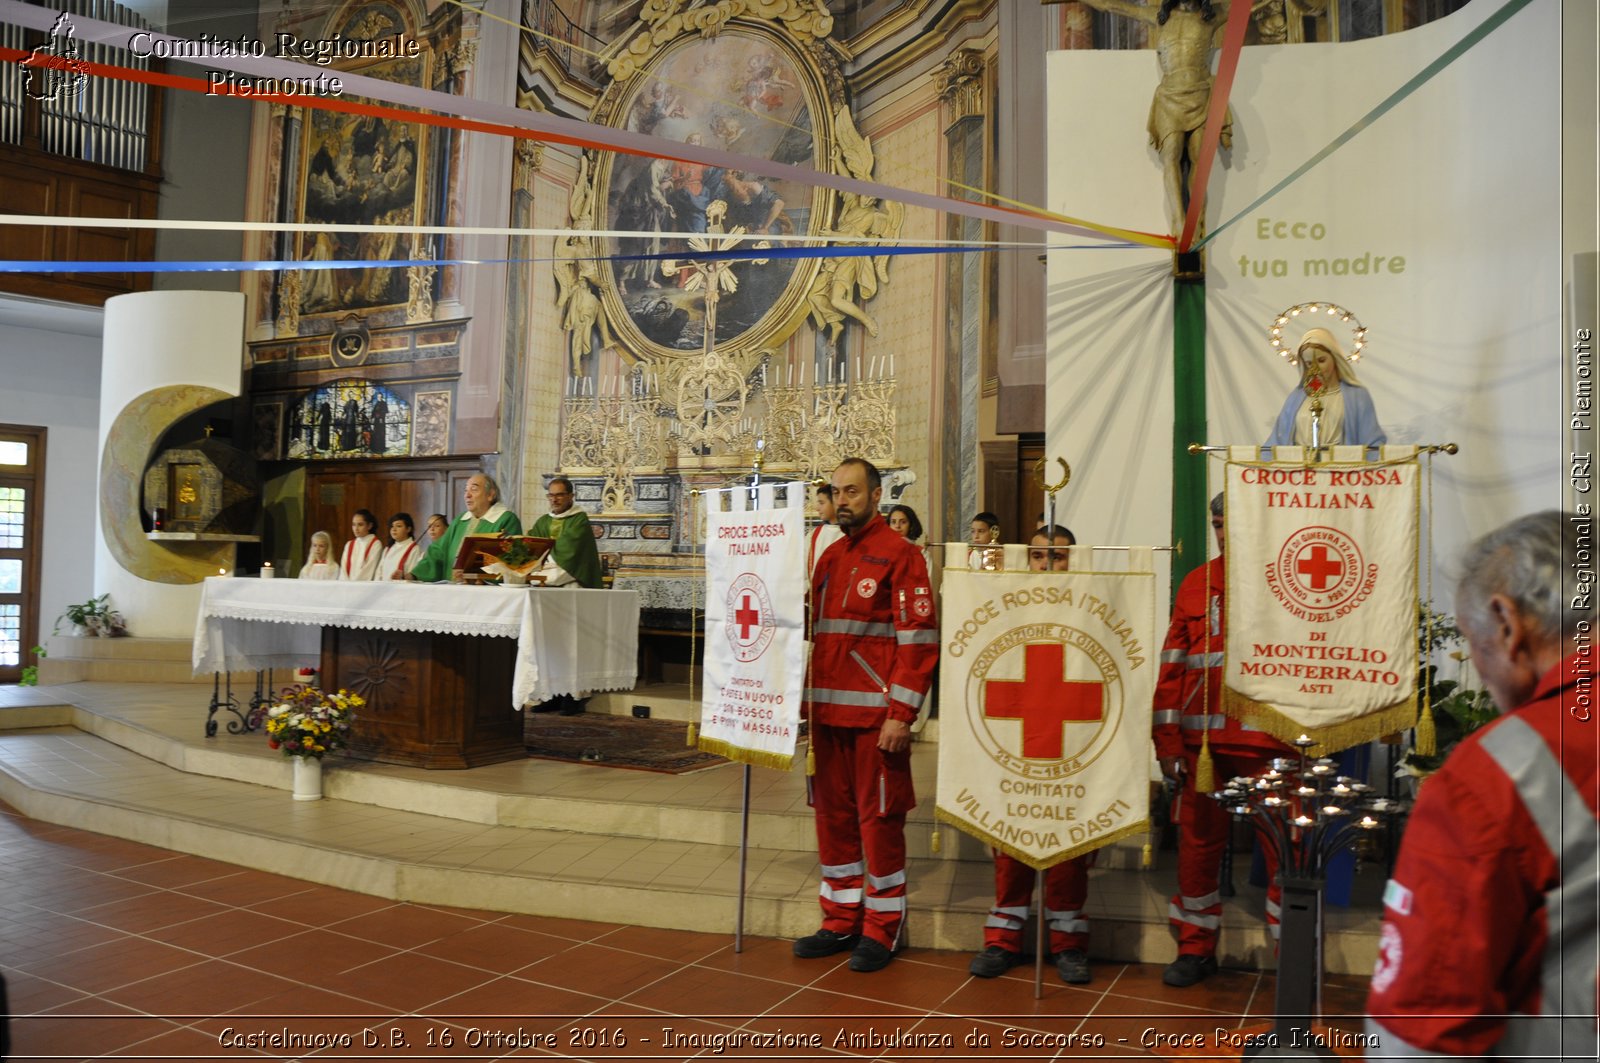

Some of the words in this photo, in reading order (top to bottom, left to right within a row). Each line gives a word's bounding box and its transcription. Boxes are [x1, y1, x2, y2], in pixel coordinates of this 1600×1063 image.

[1257, 218, 1326, 241] Ecco
[1238, 255, 1288, 278] tua
[1303, 252, 1406, 277] madre
[1241, 468, 1317, 486] CROCE
[1329, 469, 1403, 486] ROSSA
[1267, 491, 1375, 509] ITALIANA
[718, 526, 749, 539] CROCE
[751, 523, 785, 537] ROSSA
[1301, 532, 1340, 545] GINEVRA
[728, 542, 770, 556] ITALIANA
[1340, 541, 1352, 553] 22
[1283, 548, 1308, 601] CONVENZIONE
[1345, 553, 1358, 587] AGOSTO
[1264, 562, 1306, 620] VOLONTARI
[1308, 612, 1335, 623] DEL
[1336, 563, 1379, 619] SOCCORSO
[948, 600, 1000, 658] CROCE
[1002, 586, 1074, 610] ROSSA
[1078, 593, 1145, 671] ITALIANA
[1309, 631, 1327, 642] DI
[972, 625, 1053, 679] CONVENZIONE
[1059, 627, 1073, 640] DI
[1076, 634, 1120, 685] GINEVRA
[1252, 643, 1387, 664] MONTIGLIO
[1239, 662, 1399, 686] MONFERRATO
[1298, 683, 1334, 694] ASTI
[736, 706, 774, 720] BOSCO
[742, 722, 790, 738] MASSAIA
[1000, 779, 1086, 799] COMITATO
[956, 788, 1061, 849] VILLANOVA
[1007, 803, 1076, 821] LOCALE
